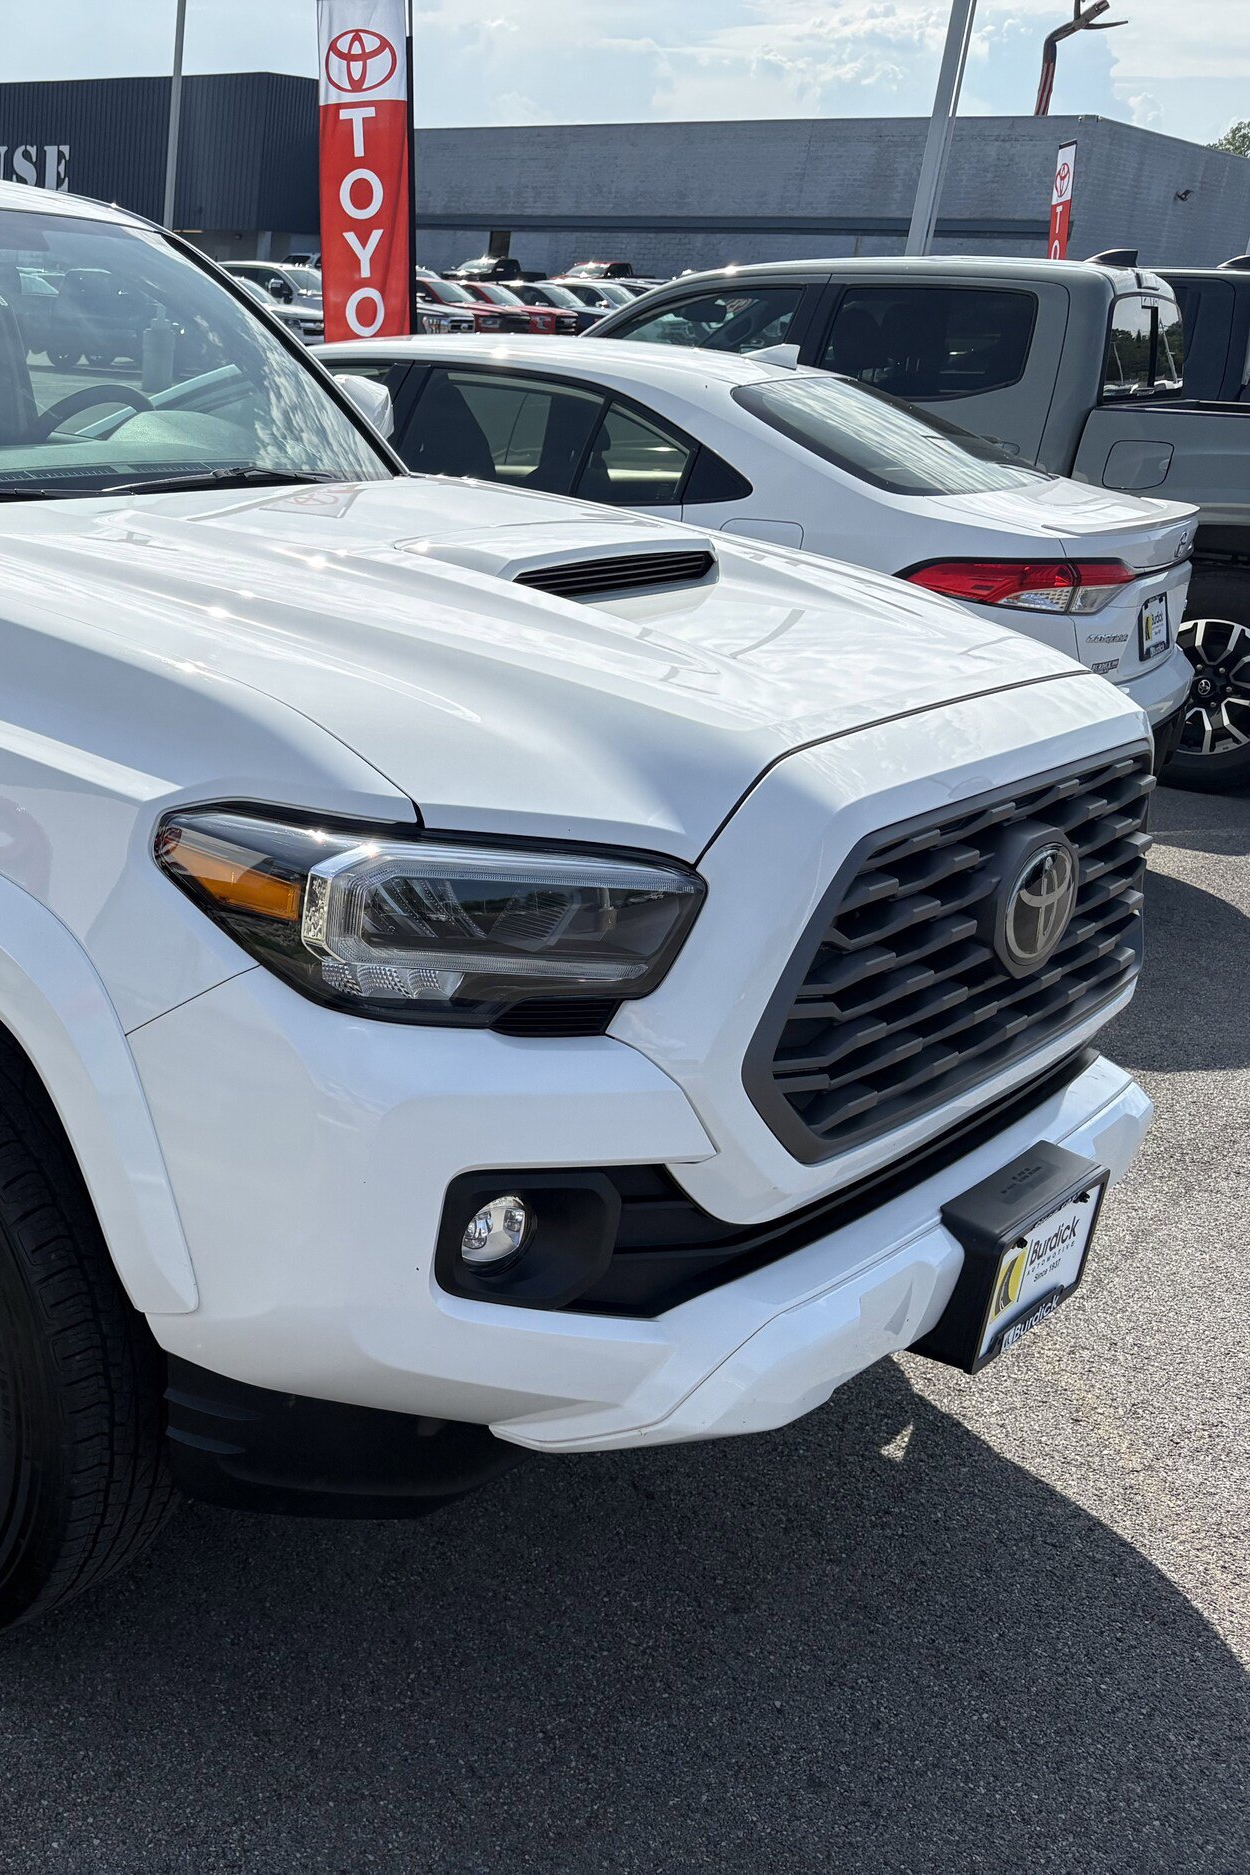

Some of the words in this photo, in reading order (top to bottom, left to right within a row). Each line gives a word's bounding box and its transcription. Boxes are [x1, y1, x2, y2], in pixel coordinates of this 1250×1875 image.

[339, 106, 385, 338] TOYO
[1026, 1240, 1075, 1276] AUTOMOTIVE
[1029, 1216, 1080, 1266] Burdick
[1013, 1294, 1060, 1342] Burdick
